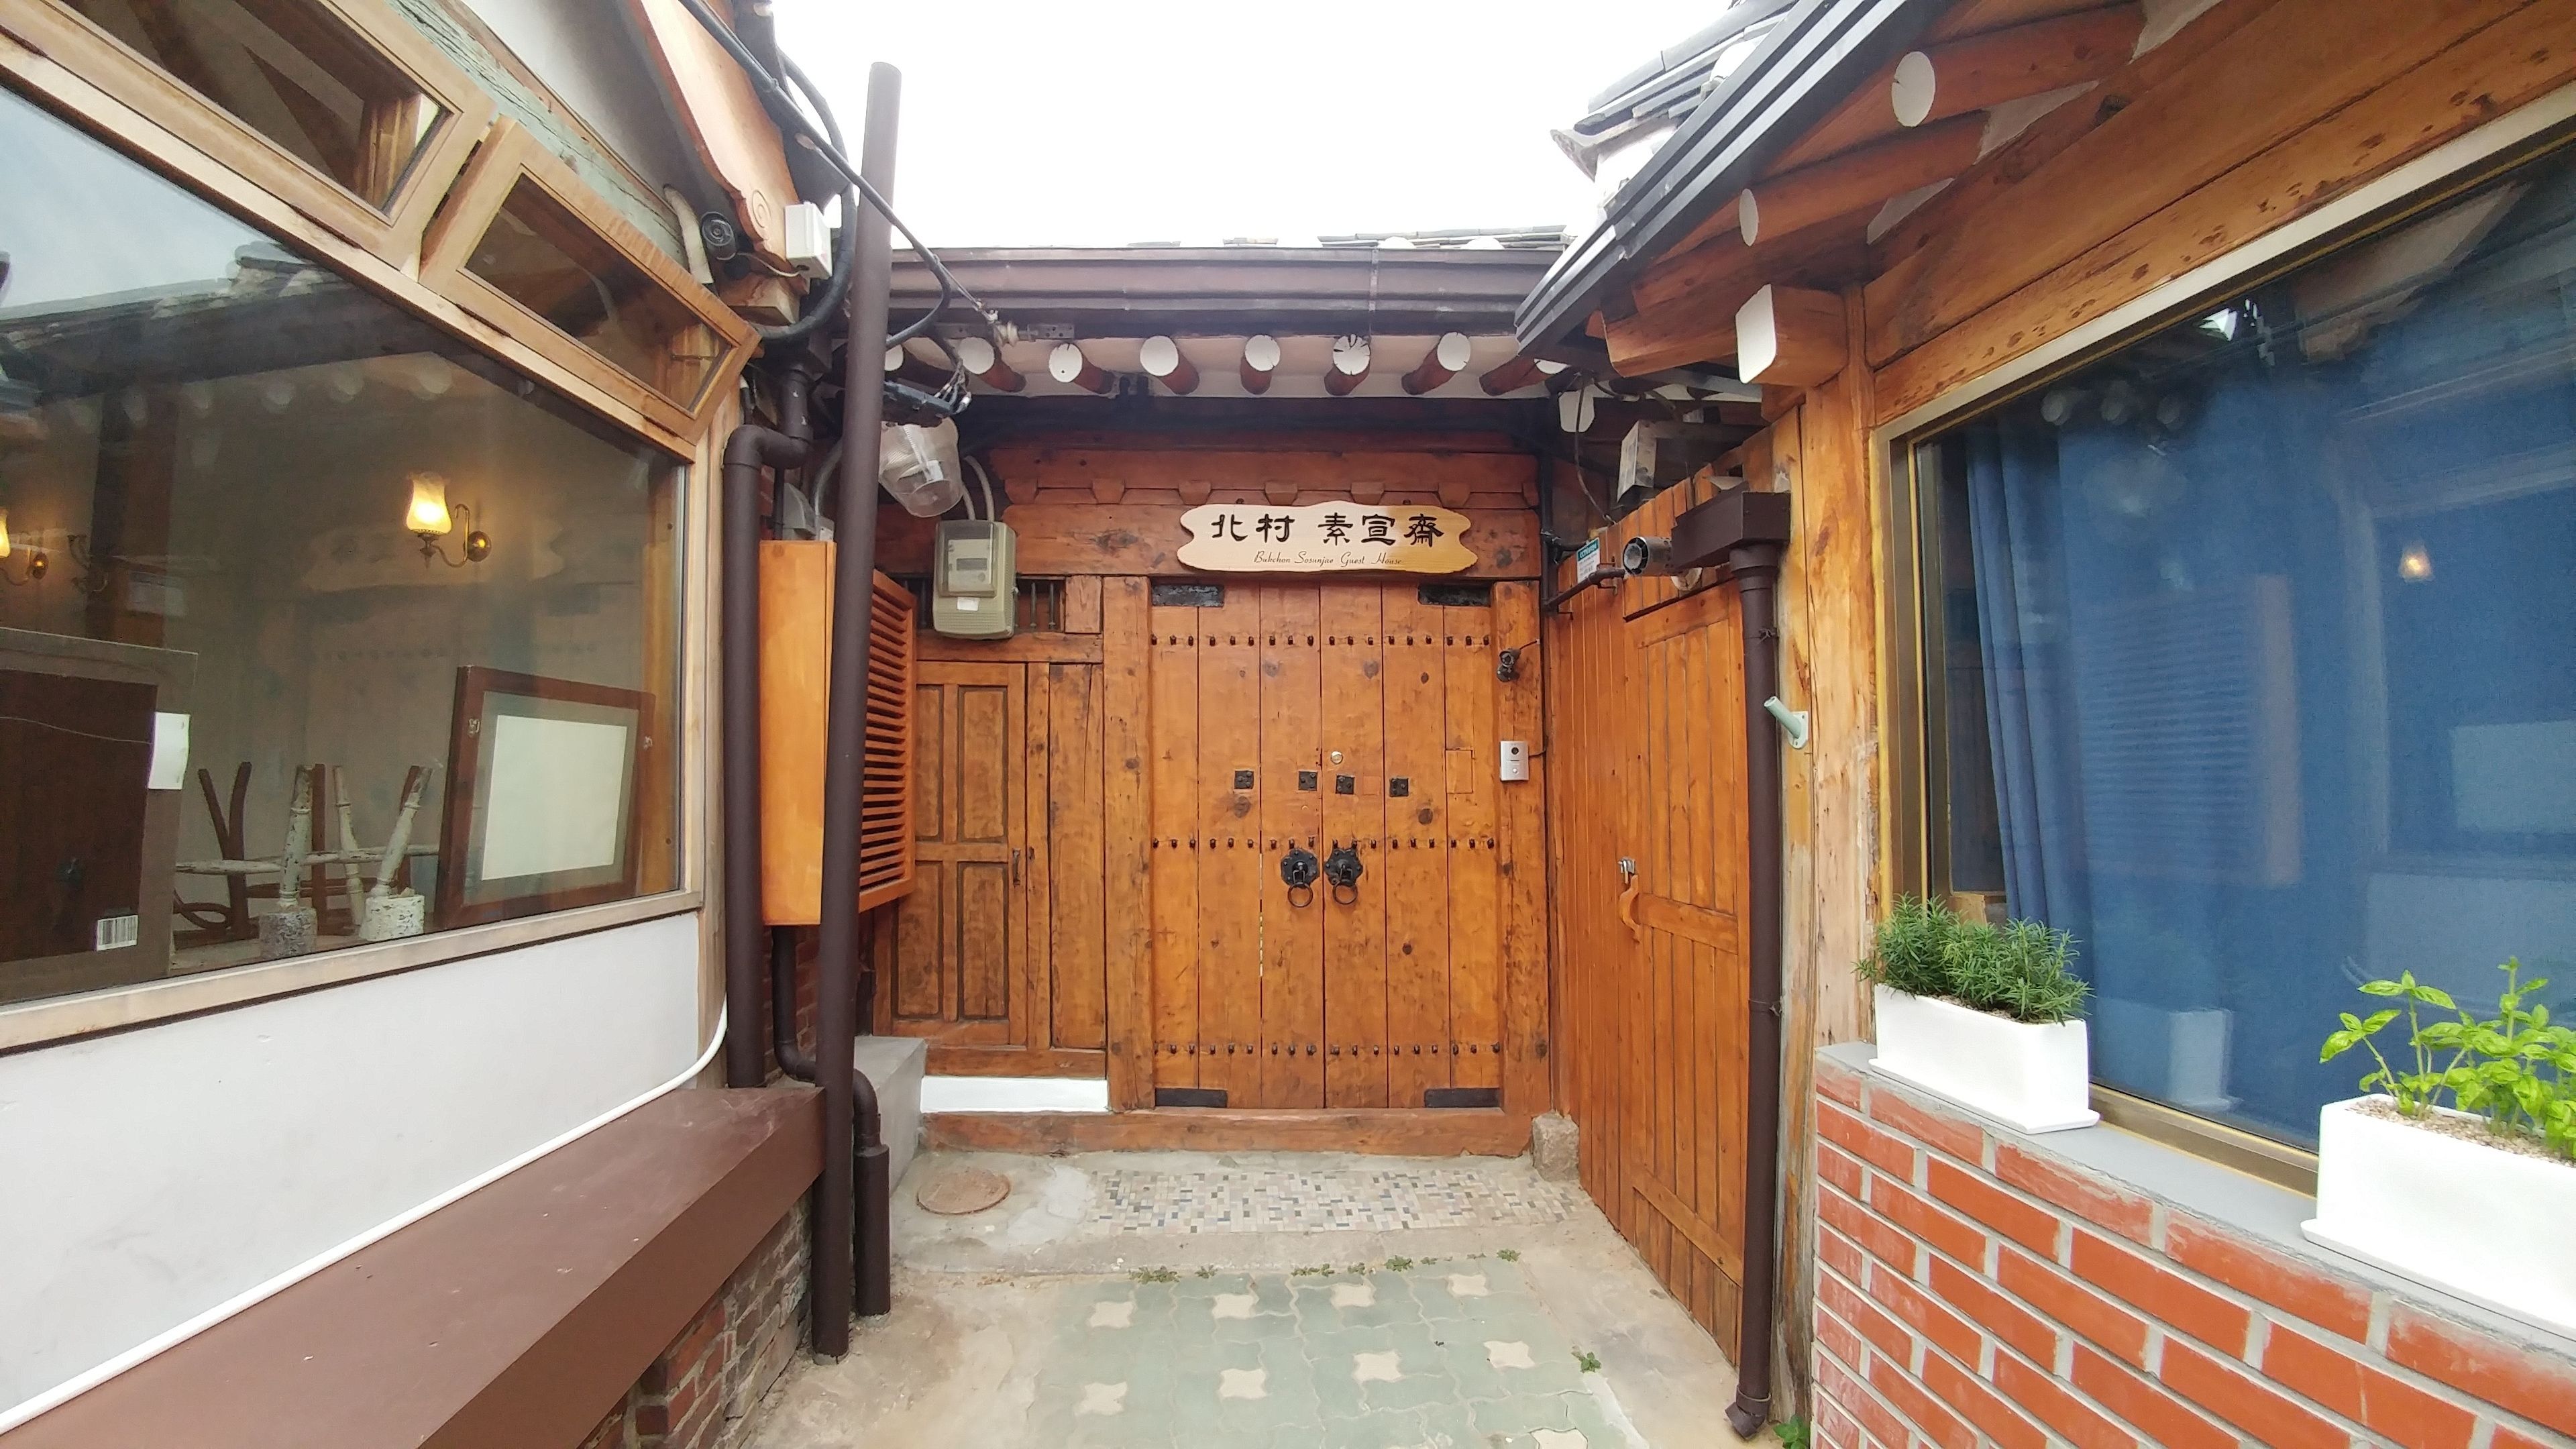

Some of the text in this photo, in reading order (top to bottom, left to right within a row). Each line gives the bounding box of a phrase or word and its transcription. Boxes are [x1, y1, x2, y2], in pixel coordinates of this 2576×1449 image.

[1211, 514, 1295, 542] 北村
[1254, 550, 1403, 568] Bukchon Sosunjae Guest House
